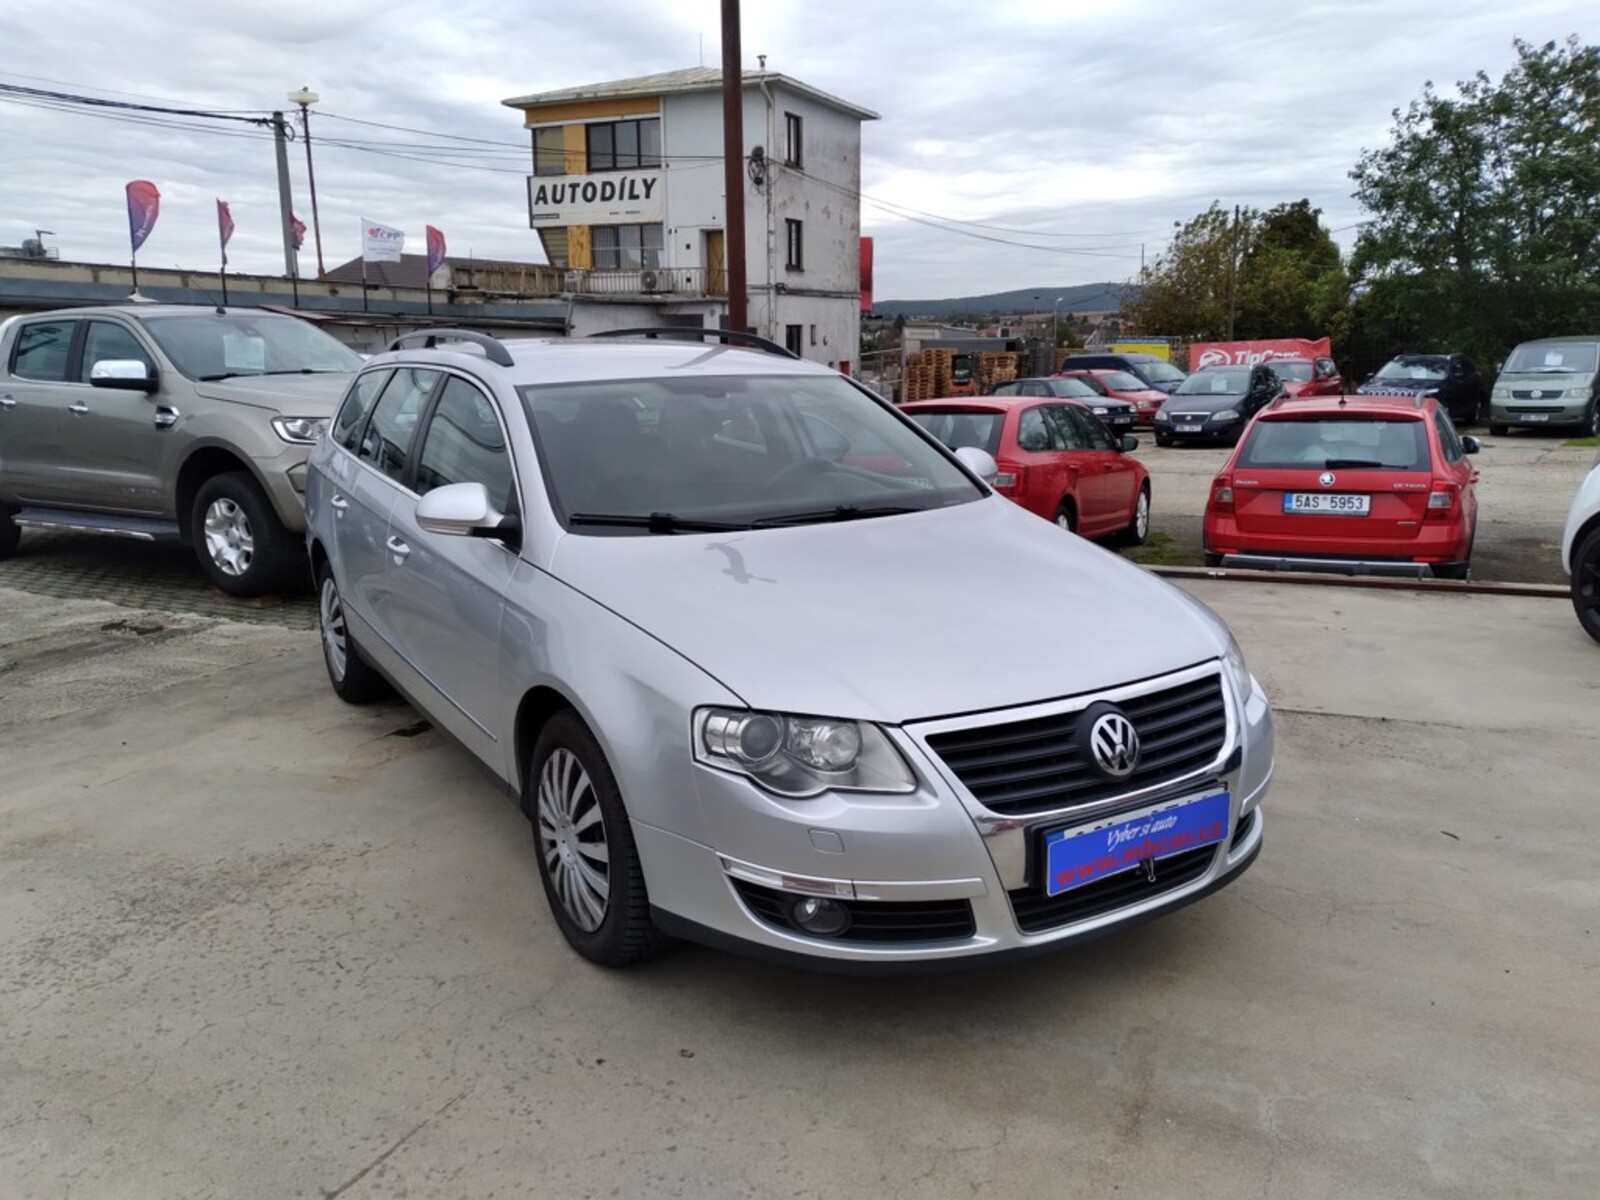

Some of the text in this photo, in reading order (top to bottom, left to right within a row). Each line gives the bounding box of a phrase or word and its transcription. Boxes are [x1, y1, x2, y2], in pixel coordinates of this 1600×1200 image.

[534, 176, 657, 206] AUTODÍLY
[1295, 495, 1364, 510] 5AS 5953
[1107, 823, 1140, 852] Vyber
[1151, 815, 1178, 833] auto
[1056, 822, 1222, 886] www.mbcar.cz
